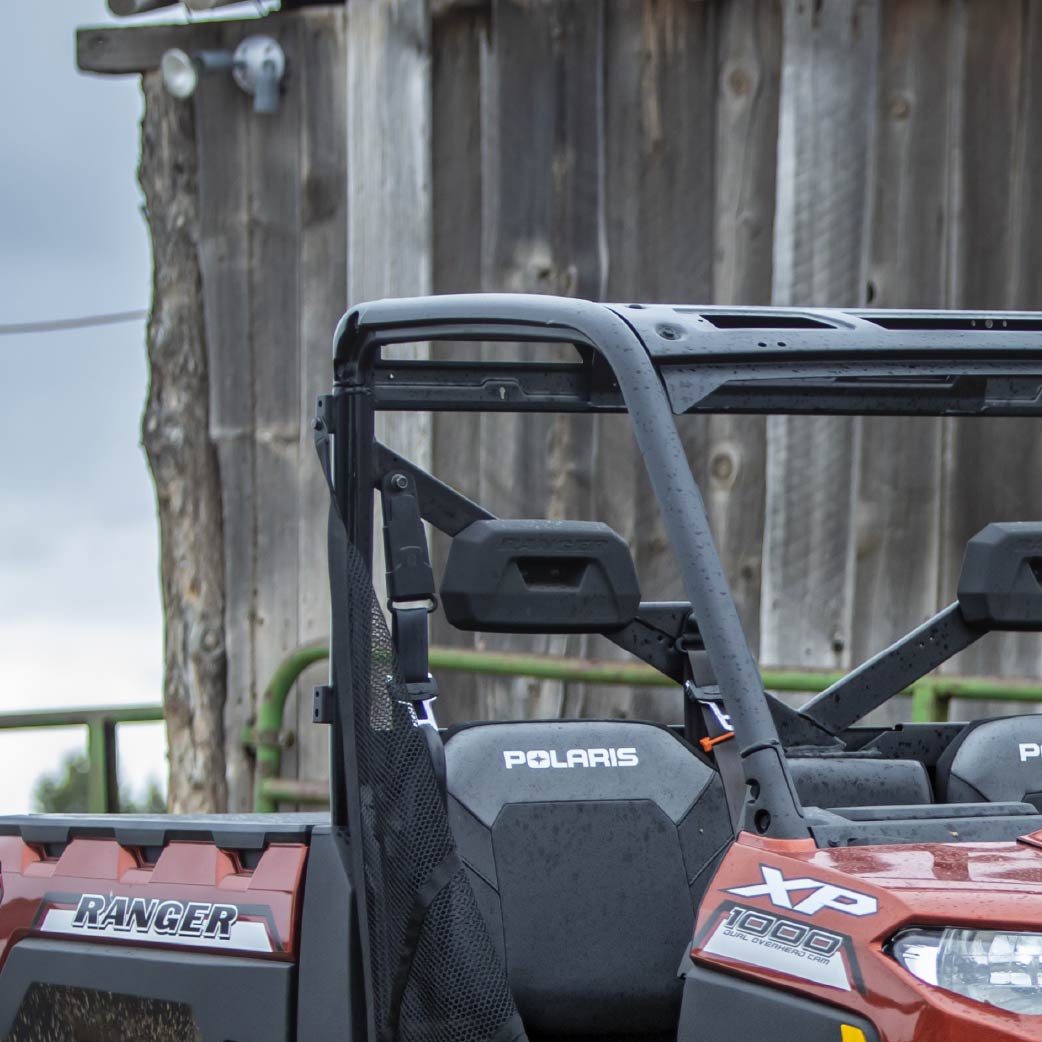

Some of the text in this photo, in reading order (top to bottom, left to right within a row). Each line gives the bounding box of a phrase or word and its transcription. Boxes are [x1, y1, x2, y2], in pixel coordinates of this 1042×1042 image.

[503, 747, 639, 769] POLARIS
[720, 864, 879, 917] XP
[72, 893, 238, 940] RANGER
[724, 906, 843, 958] 1000
[723, 929, 831, 966] DUAL OVERHEAD CAM
